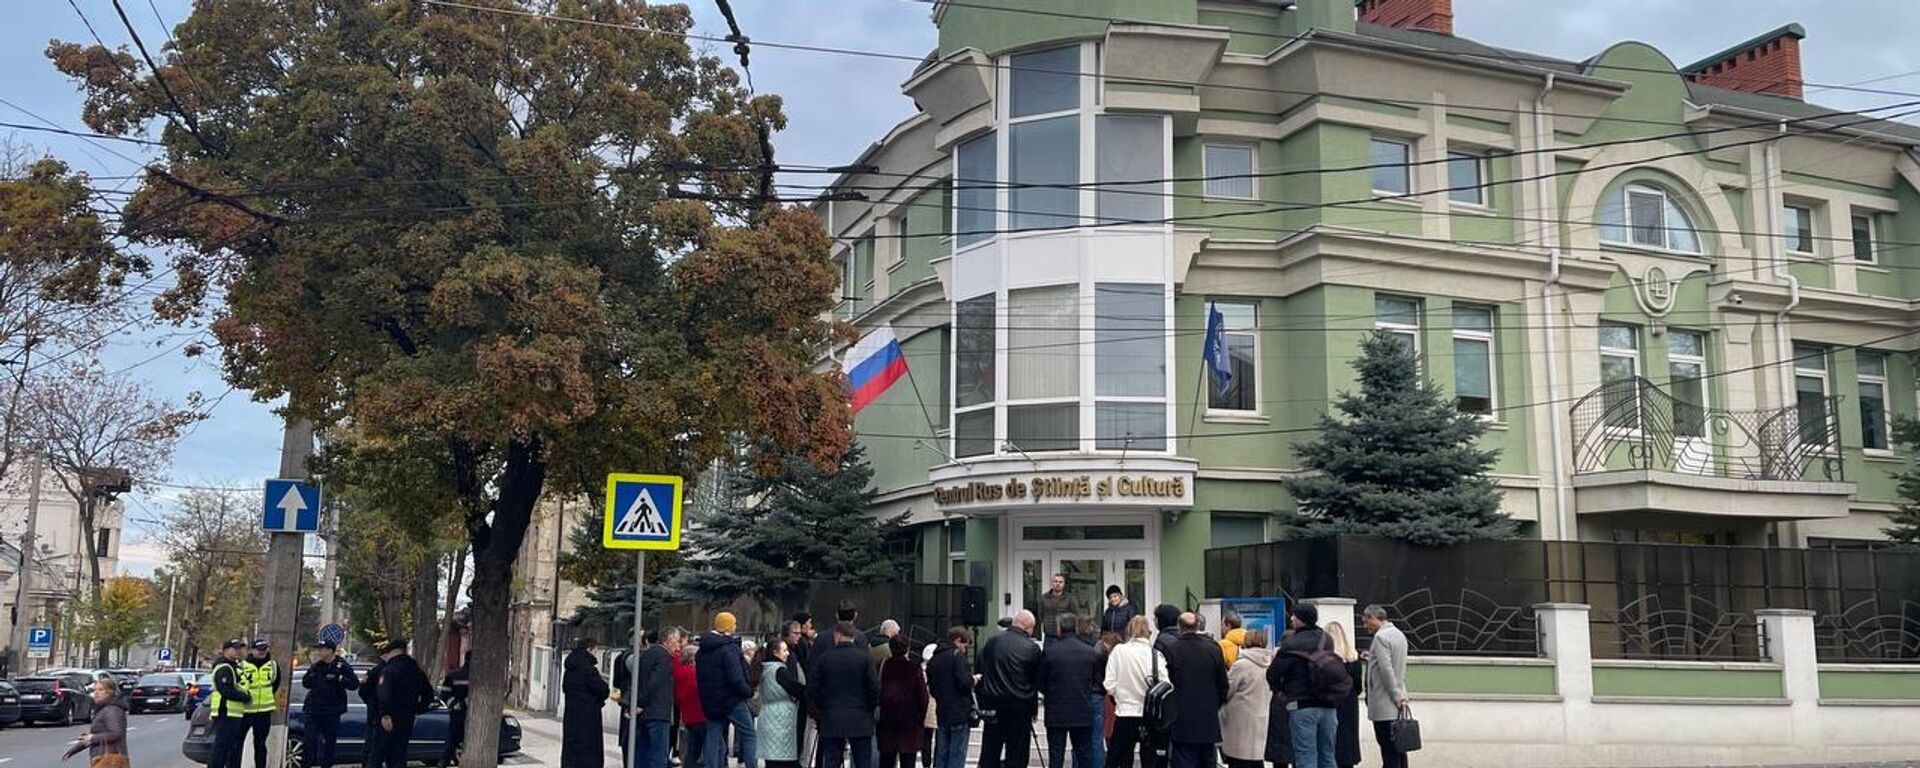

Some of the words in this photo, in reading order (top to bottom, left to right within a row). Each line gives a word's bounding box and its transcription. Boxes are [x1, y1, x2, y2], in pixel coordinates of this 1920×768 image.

[974, 481, 1003, 501] Rus
[1005, 478, 1027, 499] de
[1117, 475, 1185, 498] Cultură
[34, 629, 47, 643] P
[160, 649, 170, 660] P
